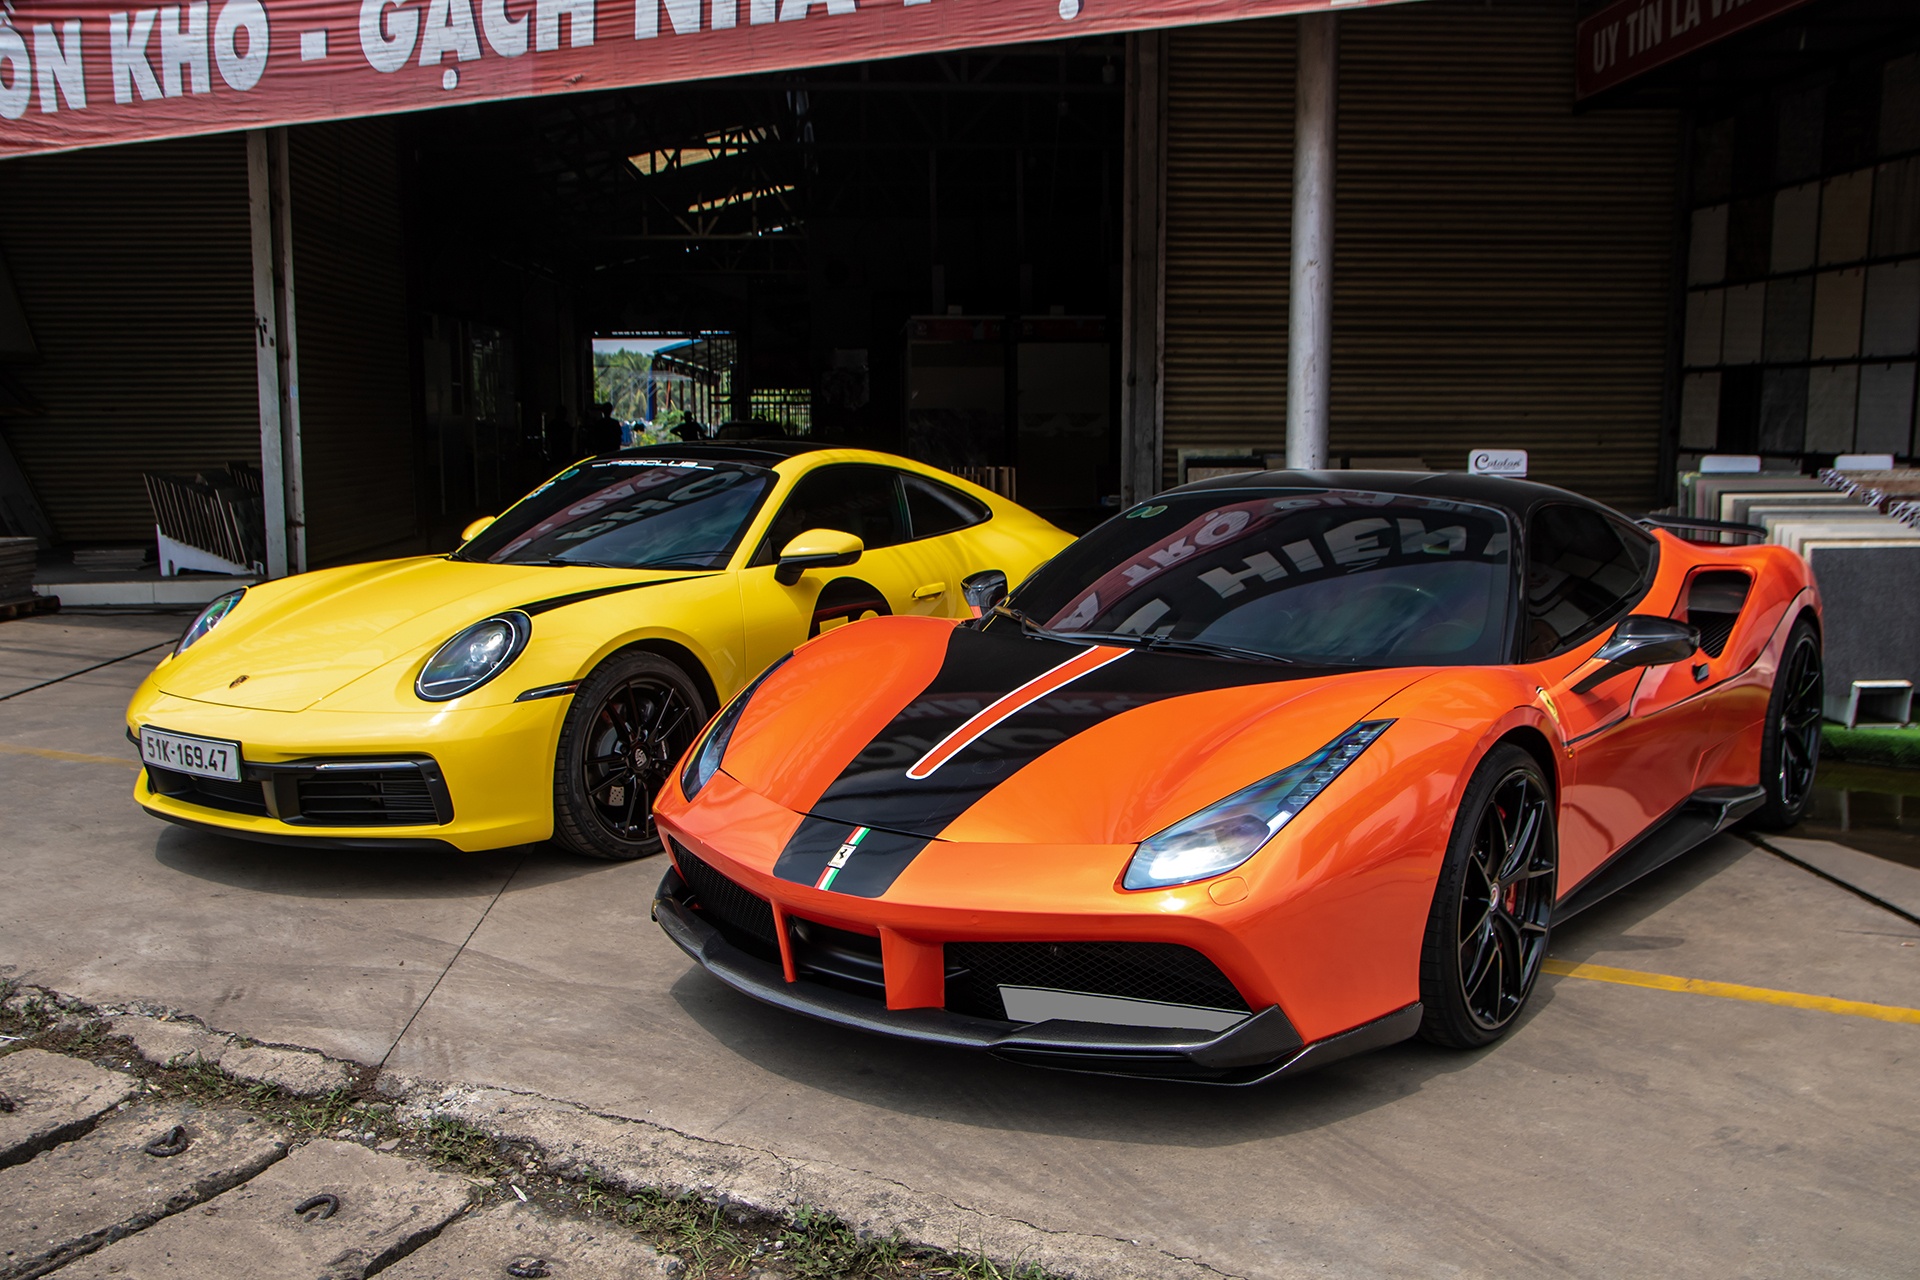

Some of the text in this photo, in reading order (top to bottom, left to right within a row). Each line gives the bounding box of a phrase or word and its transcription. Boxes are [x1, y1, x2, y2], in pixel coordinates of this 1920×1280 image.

[109, 0, 269, 104] KHO
[1593, 20, 1620, 74] UY
[147, 737, 227, 772] 51K-169.47
